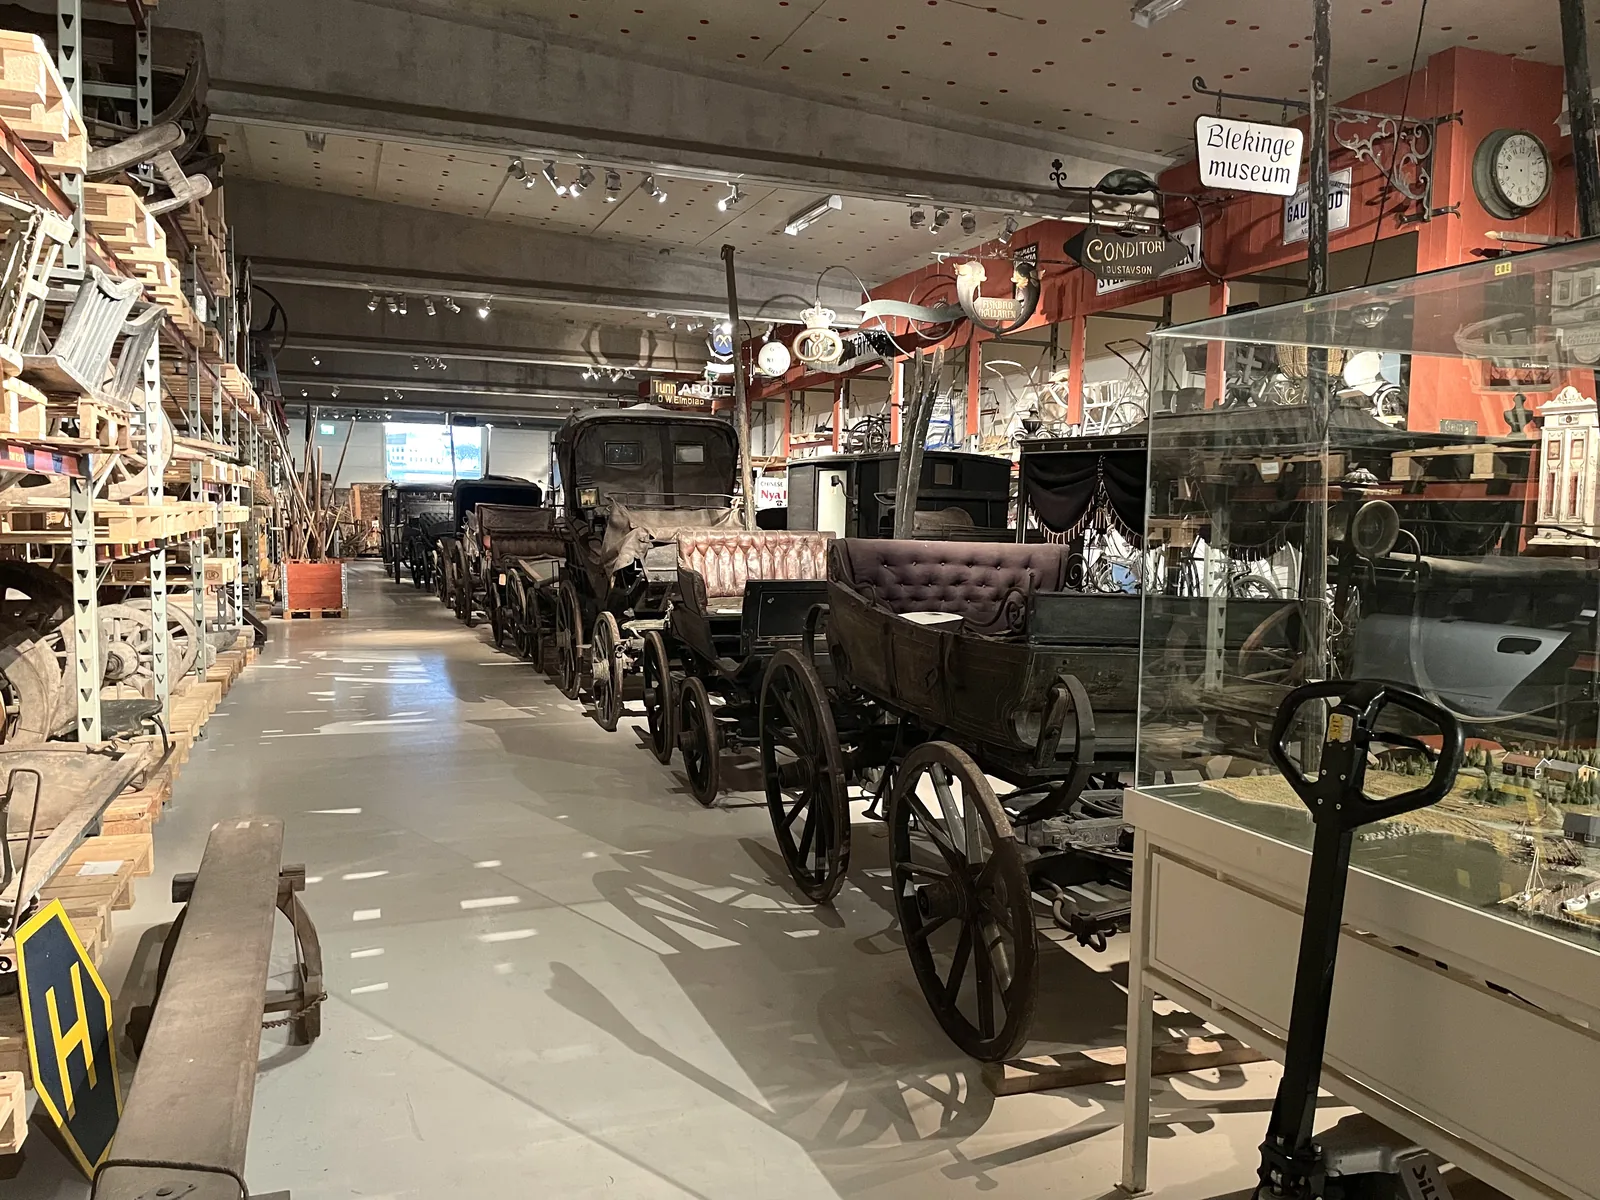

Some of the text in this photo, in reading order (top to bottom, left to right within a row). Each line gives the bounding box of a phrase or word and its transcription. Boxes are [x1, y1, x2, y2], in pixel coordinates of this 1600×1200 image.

[1207, 124, 1295, 163] Blekinge
[1208, 160, 1290, 184] museum
[1086, 239, 1165, 263] CONDITORI
[1106, 265, 1153, 274] GUSTAVSON
[761, 490, 780, 501] Nya
[46, 961, 97, 1121] H
